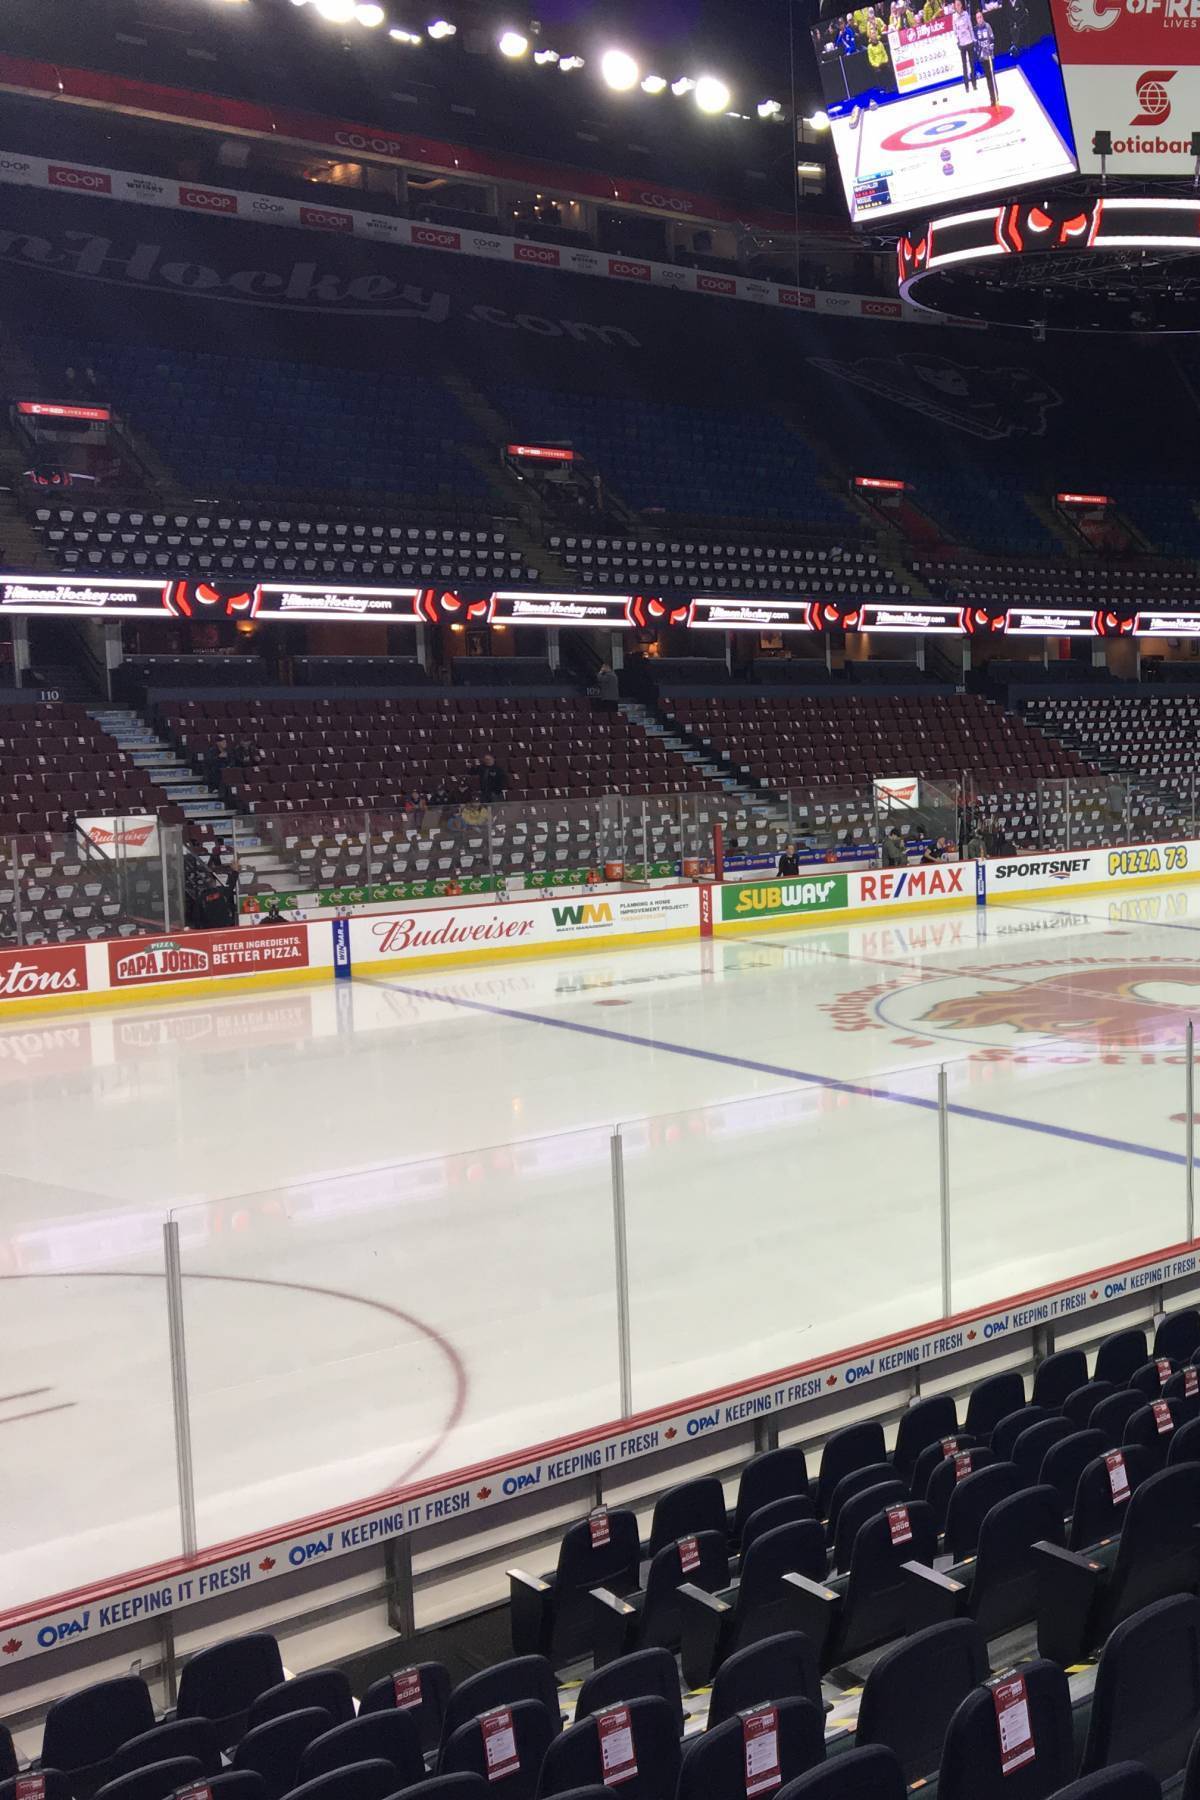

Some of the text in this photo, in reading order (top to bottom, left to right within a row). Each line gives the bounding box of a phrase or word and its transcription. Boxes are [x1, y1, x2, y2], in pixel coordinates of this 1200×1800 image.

[1126, 0, 1160, 14] OF
[1164, 19, 1197, 28] LIVES
[4, 585, 137, 606] HitmenHockey.com
[280, 593, 393, 612] HitmenHockey.com
[512, 600, 607, 617] HitmenHockey.com
[707, 606, 789, 623] HitmenHockey.com
[41, 690, 60, 701] 110
[995, 859, 1090, 879] SPORTSNET
[1108, 846, 1188, 876] PIZZA 73
[735, 880, 837, 913] SUBWAY
[860, 868, 965, 901] RE/MAX
[552, 902, 613, 926] WM
[619, 906, 660, 915] IMPROVEMENT
[150, 941, 175, 950] PIZZA
[213, 936, 301, 952] BETTER INGREDIENTS.
[372, 917, 535, 953] Budweiser
[119, 951, 207, 978] PAPA JOHNS
[213, 947, 302, 965] BETTER PIZZA.
[1104, 1256, 1196, 1298] OPA! KEEPING IT FRESH
[983, 1292, 1087, 1338] OPA! KEEPING IT FRESH
[846, 1332, 963, 1384] OPA! KEEPING IT FRESH
[686, 1377, 822, 1437] OPA! KEEPING IT FRESH
[502, 1430, 659, 1495] OPA! KEEPING IT FRESH
[288, 1491, 471, 1566] OPA! KEEPING IT FRESH
[37, 1562, 252, 1649] OPA! KEEPING IT FRESH
